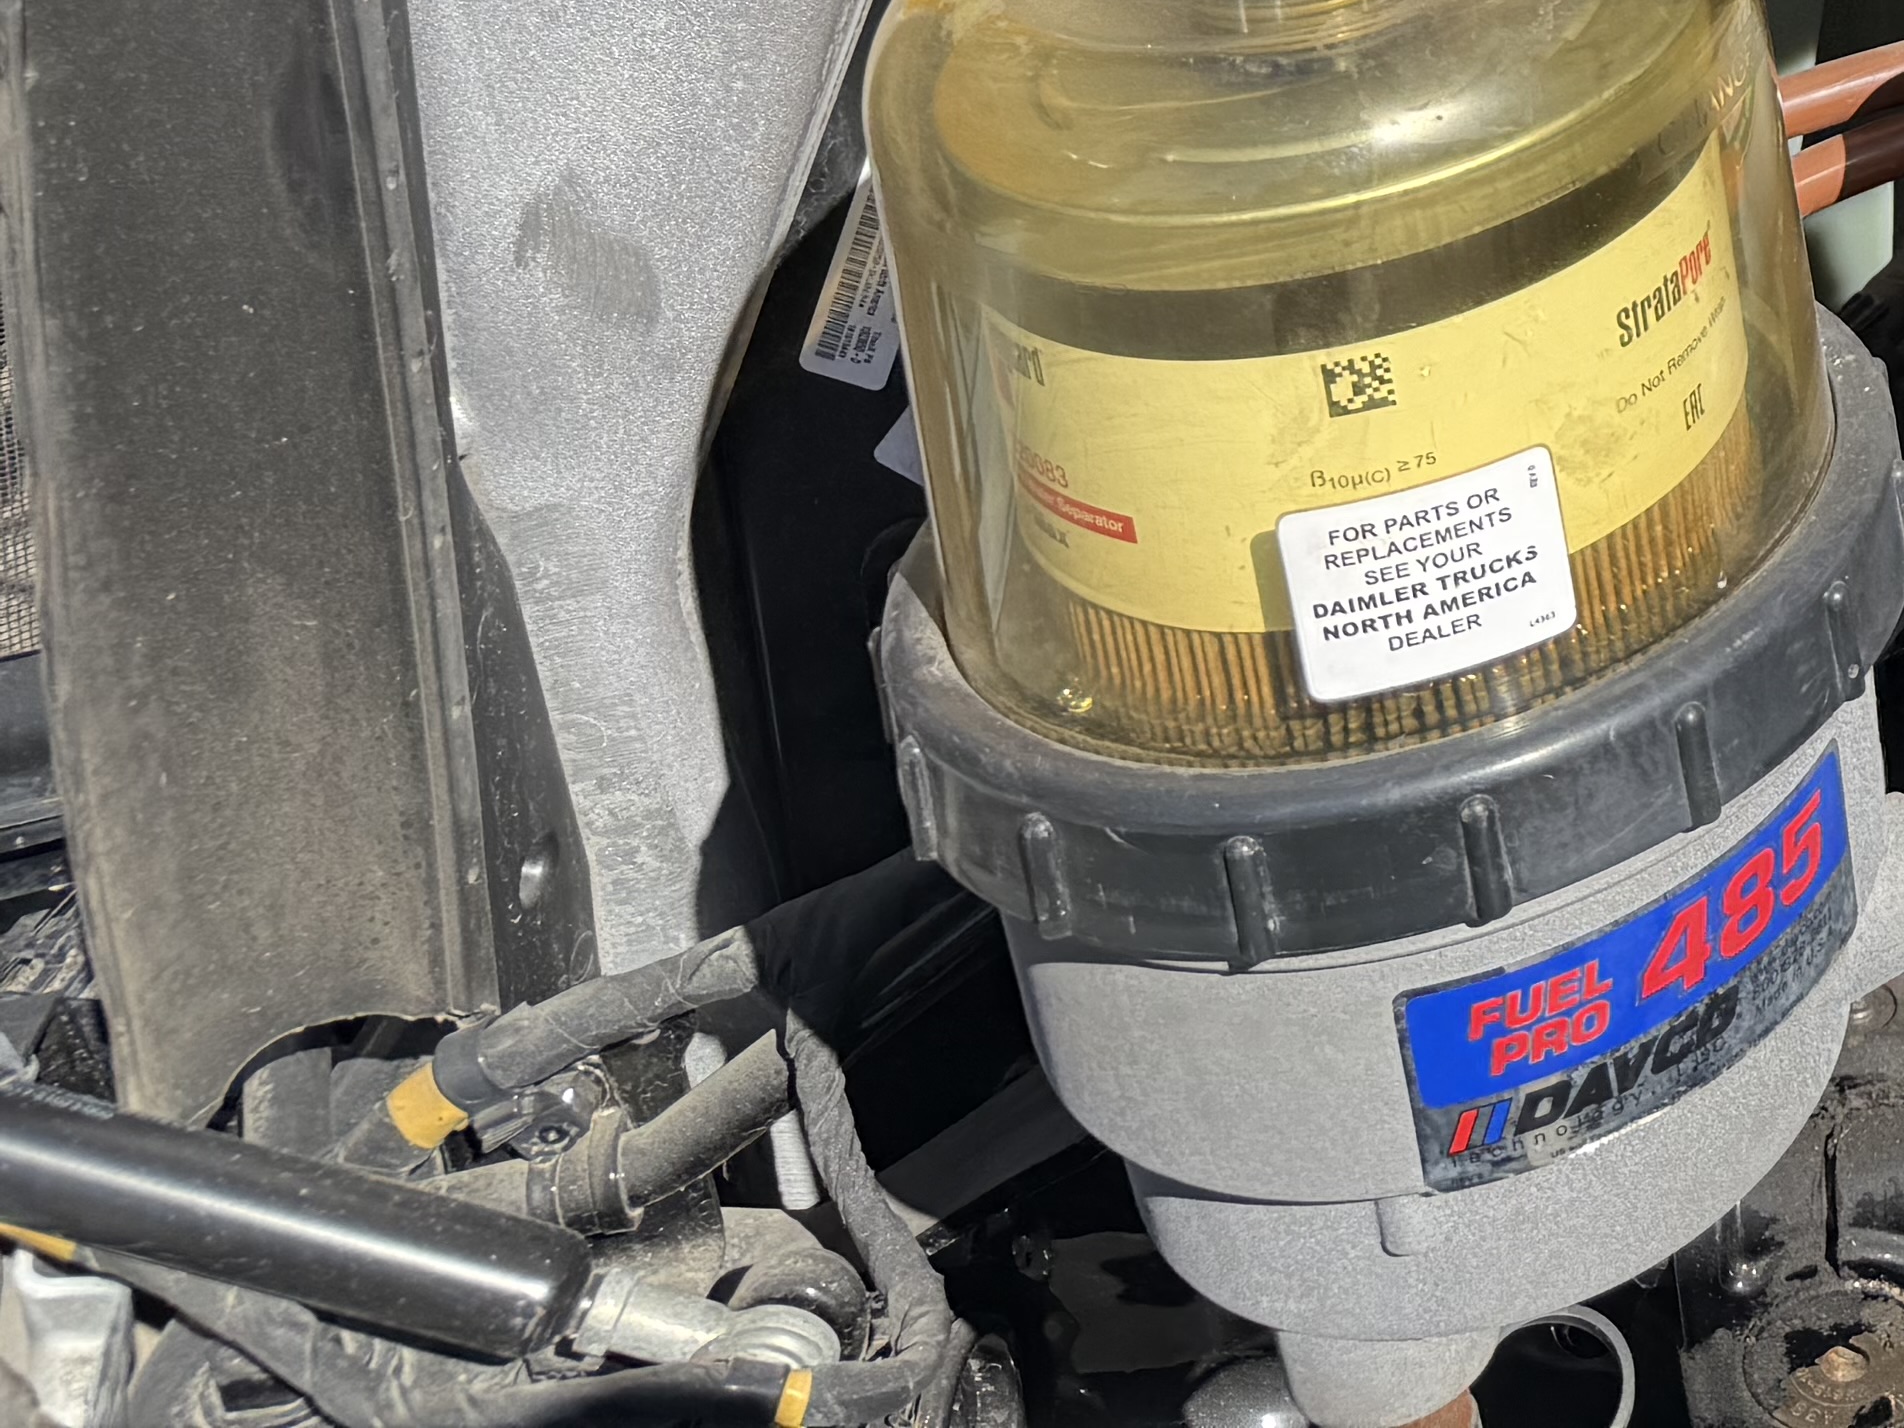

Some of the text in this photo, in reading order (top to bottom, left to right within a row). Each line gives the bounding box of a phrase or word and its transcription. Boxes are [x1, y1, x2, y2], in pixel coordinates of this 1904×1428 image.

[1616, 231, 1712, 348] StrataPore
[1616, 325, 1708, 413] Do Not Remove
[1414, 451, 1437, 469] 75
[1056, 496, 1124, 533] Separator
[1324, 507, 1512, 570] REPLACEMENTS
[1328, 488, 1500, 546] FOR PARTS OR
[1313, 545, 1538, 619] DAIMLER TRUCKS
[1364, 542, 1483, 585] SEE YOUR
[1323, 571, 1537, 641] NORTH AMERICA
[1388, 614, 1482, 651] DEALER
[1467, 787, 1823, 1042] FUEL 485
[1489, 999, 1612, 1079] PRO
[1514, 987, 1740, 1135] DAVCO
